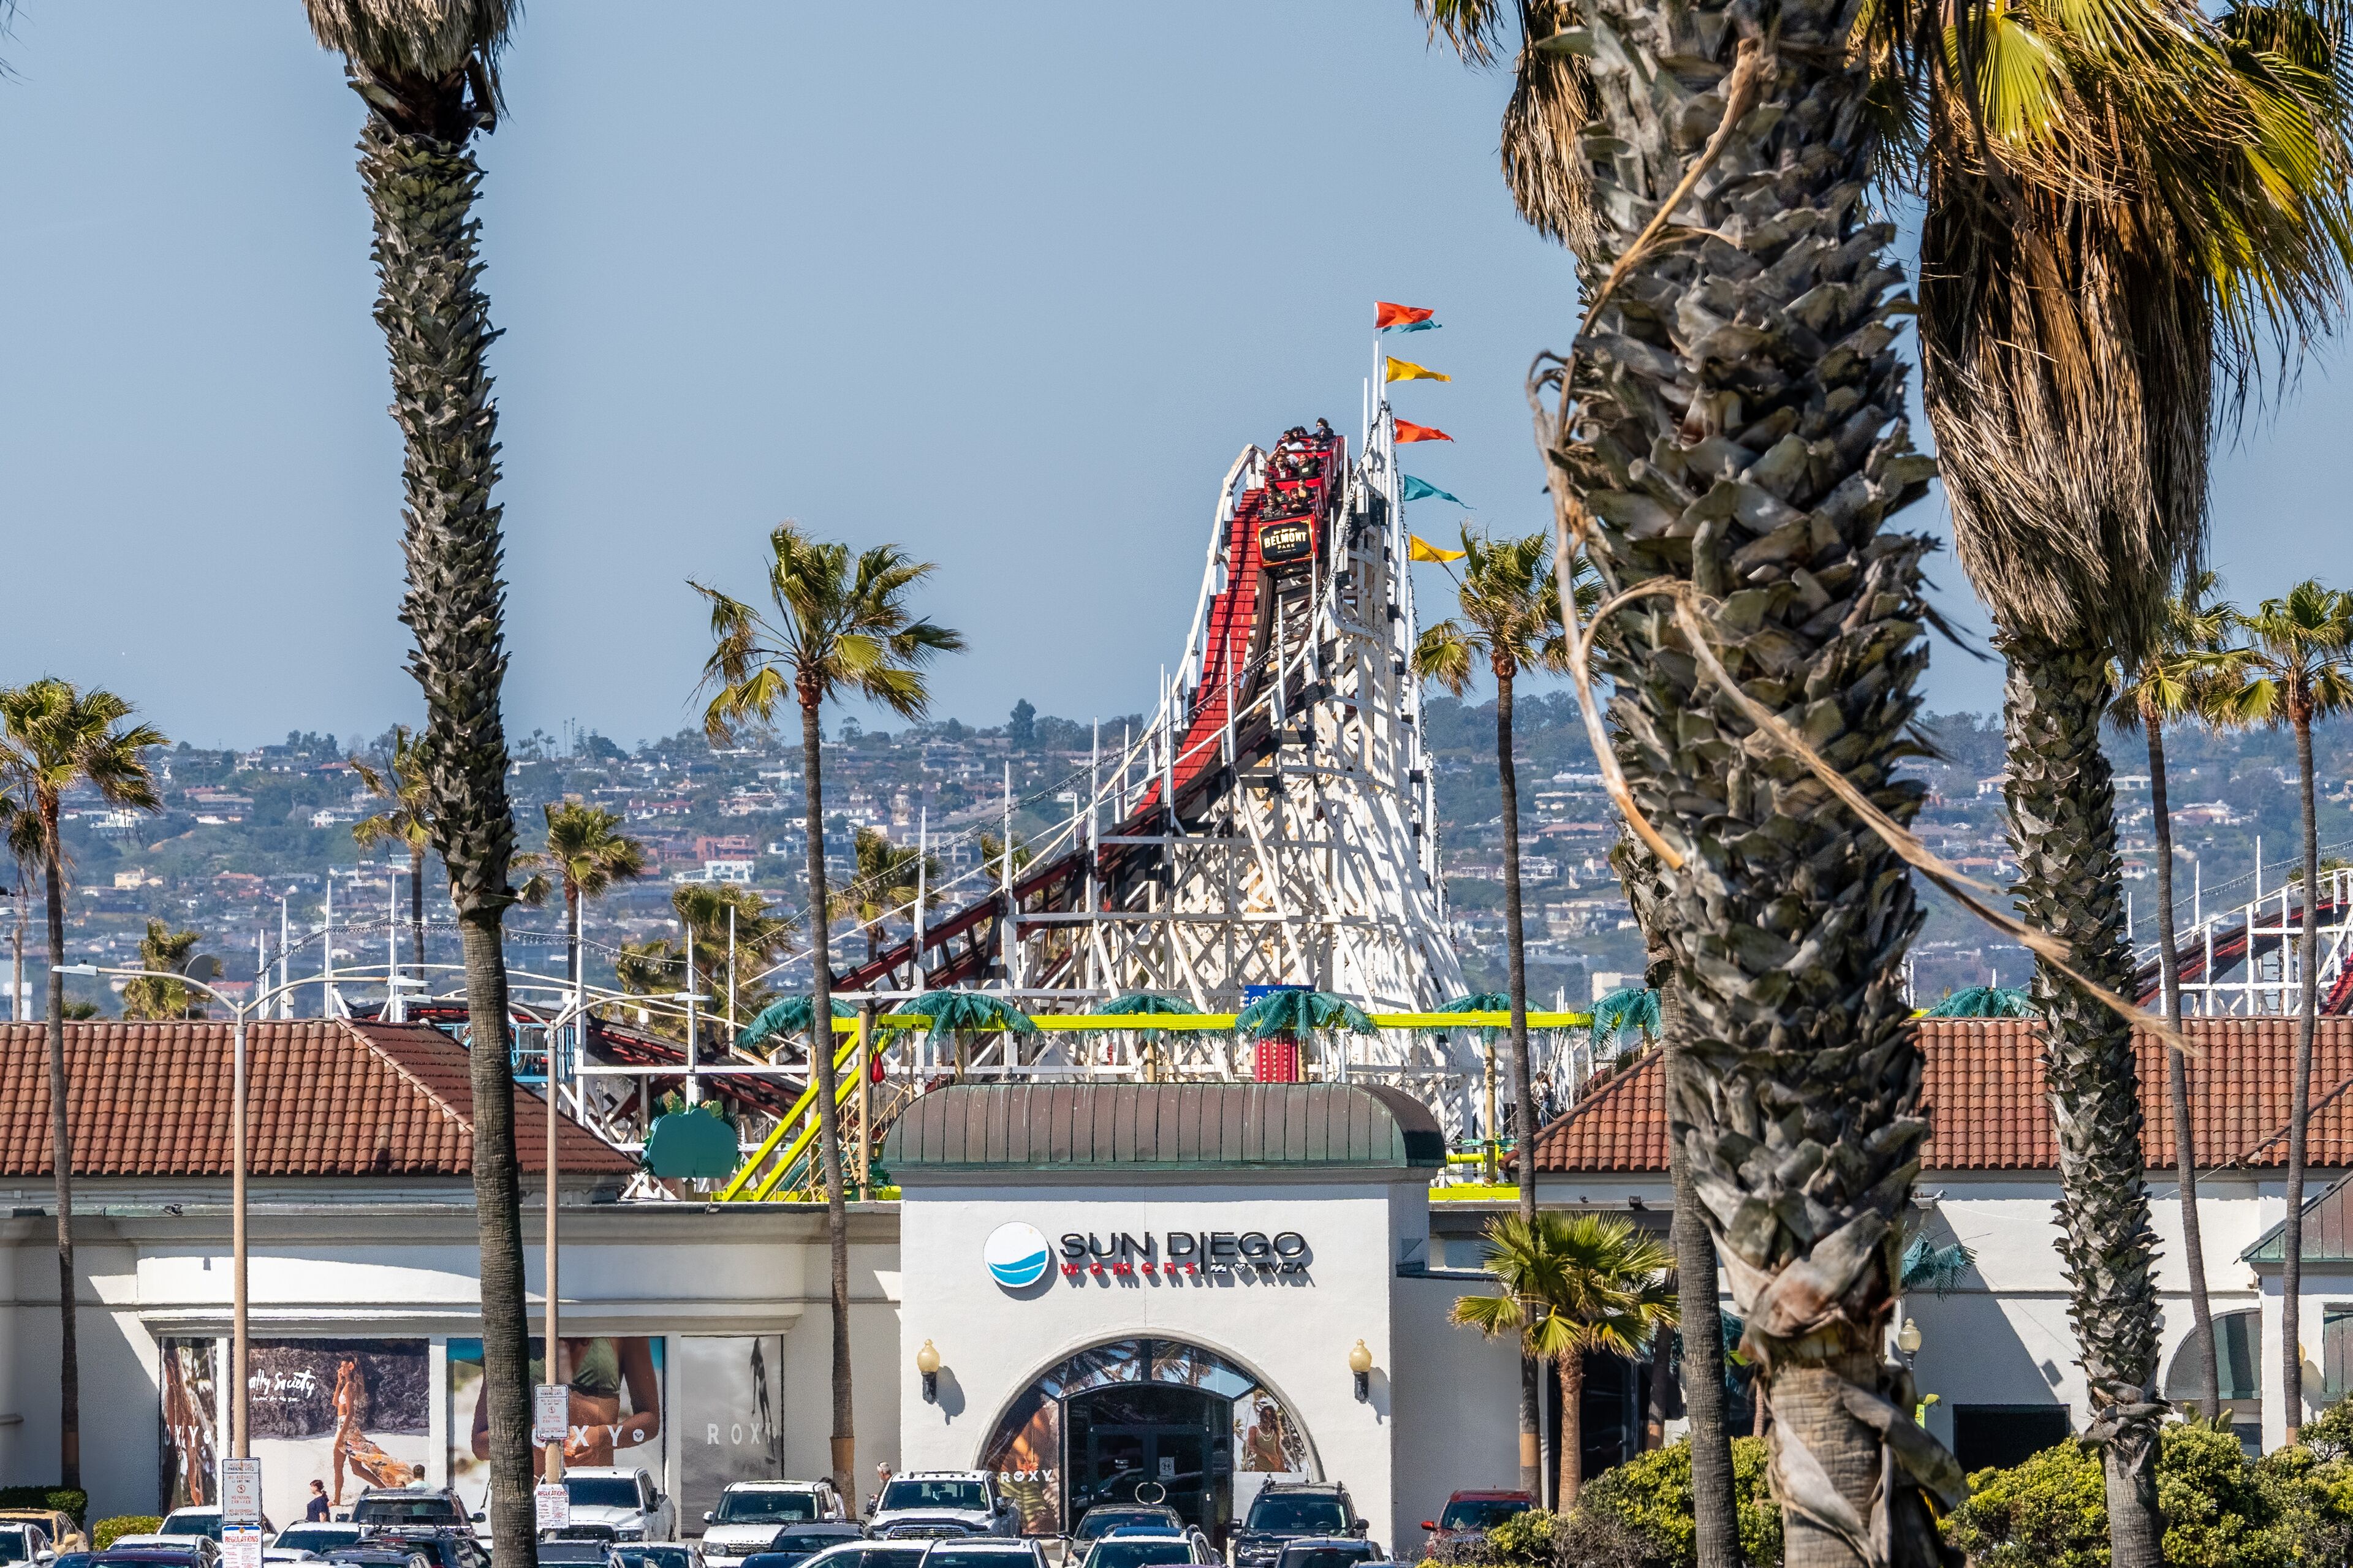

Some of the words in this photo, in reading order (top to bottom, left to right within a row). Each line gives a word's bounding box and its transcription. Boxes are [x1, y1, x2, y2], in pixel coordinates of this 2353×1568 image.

[1264, 532, 1306, 548] BELMONT
[1059, 1232, 1150, 1258] SUN
[1167, 1232, 1306, 1274] DIEGO
[1060, 1262, 1196, 1276] womens
[1256, 1262, 1307, 1274] RVCA
[248, 1368, 270, 1396] alty
[274, 1369, 316, 1399] Society
[164, 1424, 199, 1447] OXY
[532, 1425, 624, 1448] OXY
[707, 1423, 771, 1445] ROXY
[1000, 1469, 1053, 1483] ROXY
